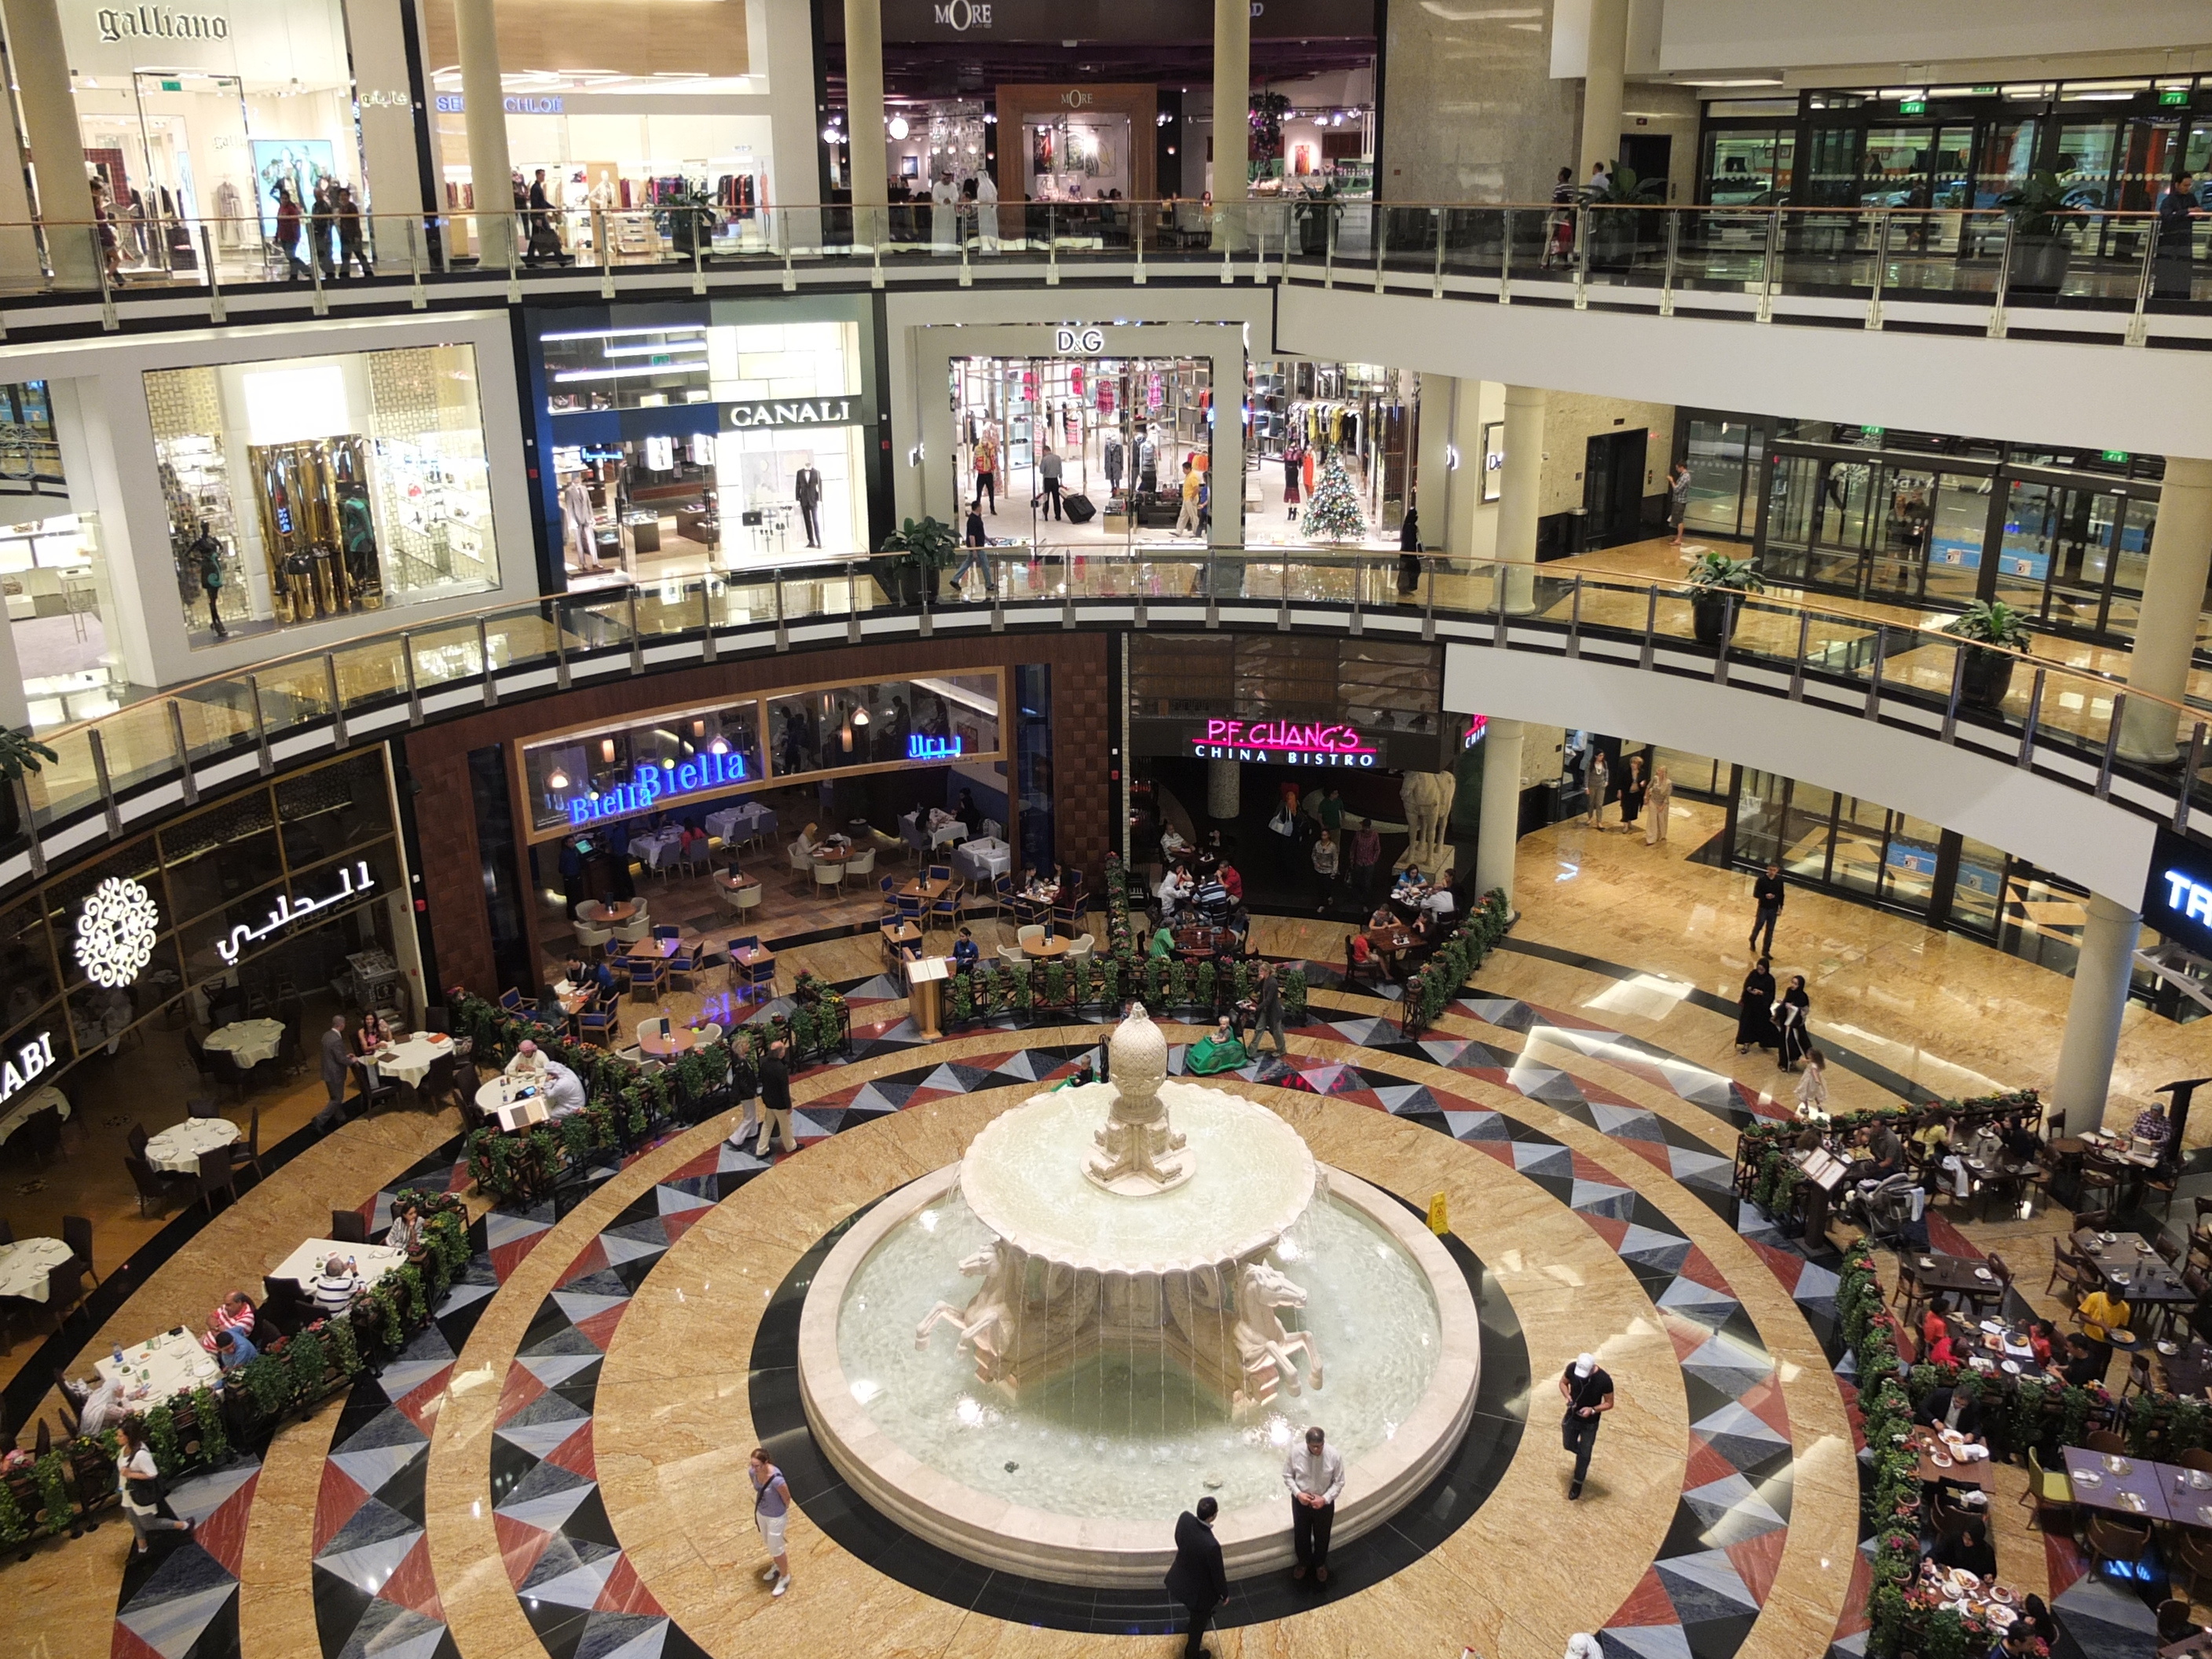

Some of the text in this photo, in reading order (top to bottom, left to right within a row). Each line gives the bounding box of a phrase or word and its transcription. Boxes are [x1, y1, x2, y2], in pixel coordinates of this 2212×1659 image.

[97, 5, 229, 42] galliano
[934, 0, 992, 31] MORE
[504, 95, 564, 113] CHLOÉ
[1060, 89, 1093, 108] MORE
[1057, 330, 1102, 353] D&G
[730, 401, 851, 427] CANALI
[1207, 719, 1244, 746] P.F.
[1195, 745, 1373, 767] CHINA BISTRO
[638, 752, 746, 798] Biella
[570, 785, 654, 824] Biella
[216, 861, 375, 965] الحلبي
[2164, 870, 2212, 929] TR
[0, 1031, 56, 1104] ABI
